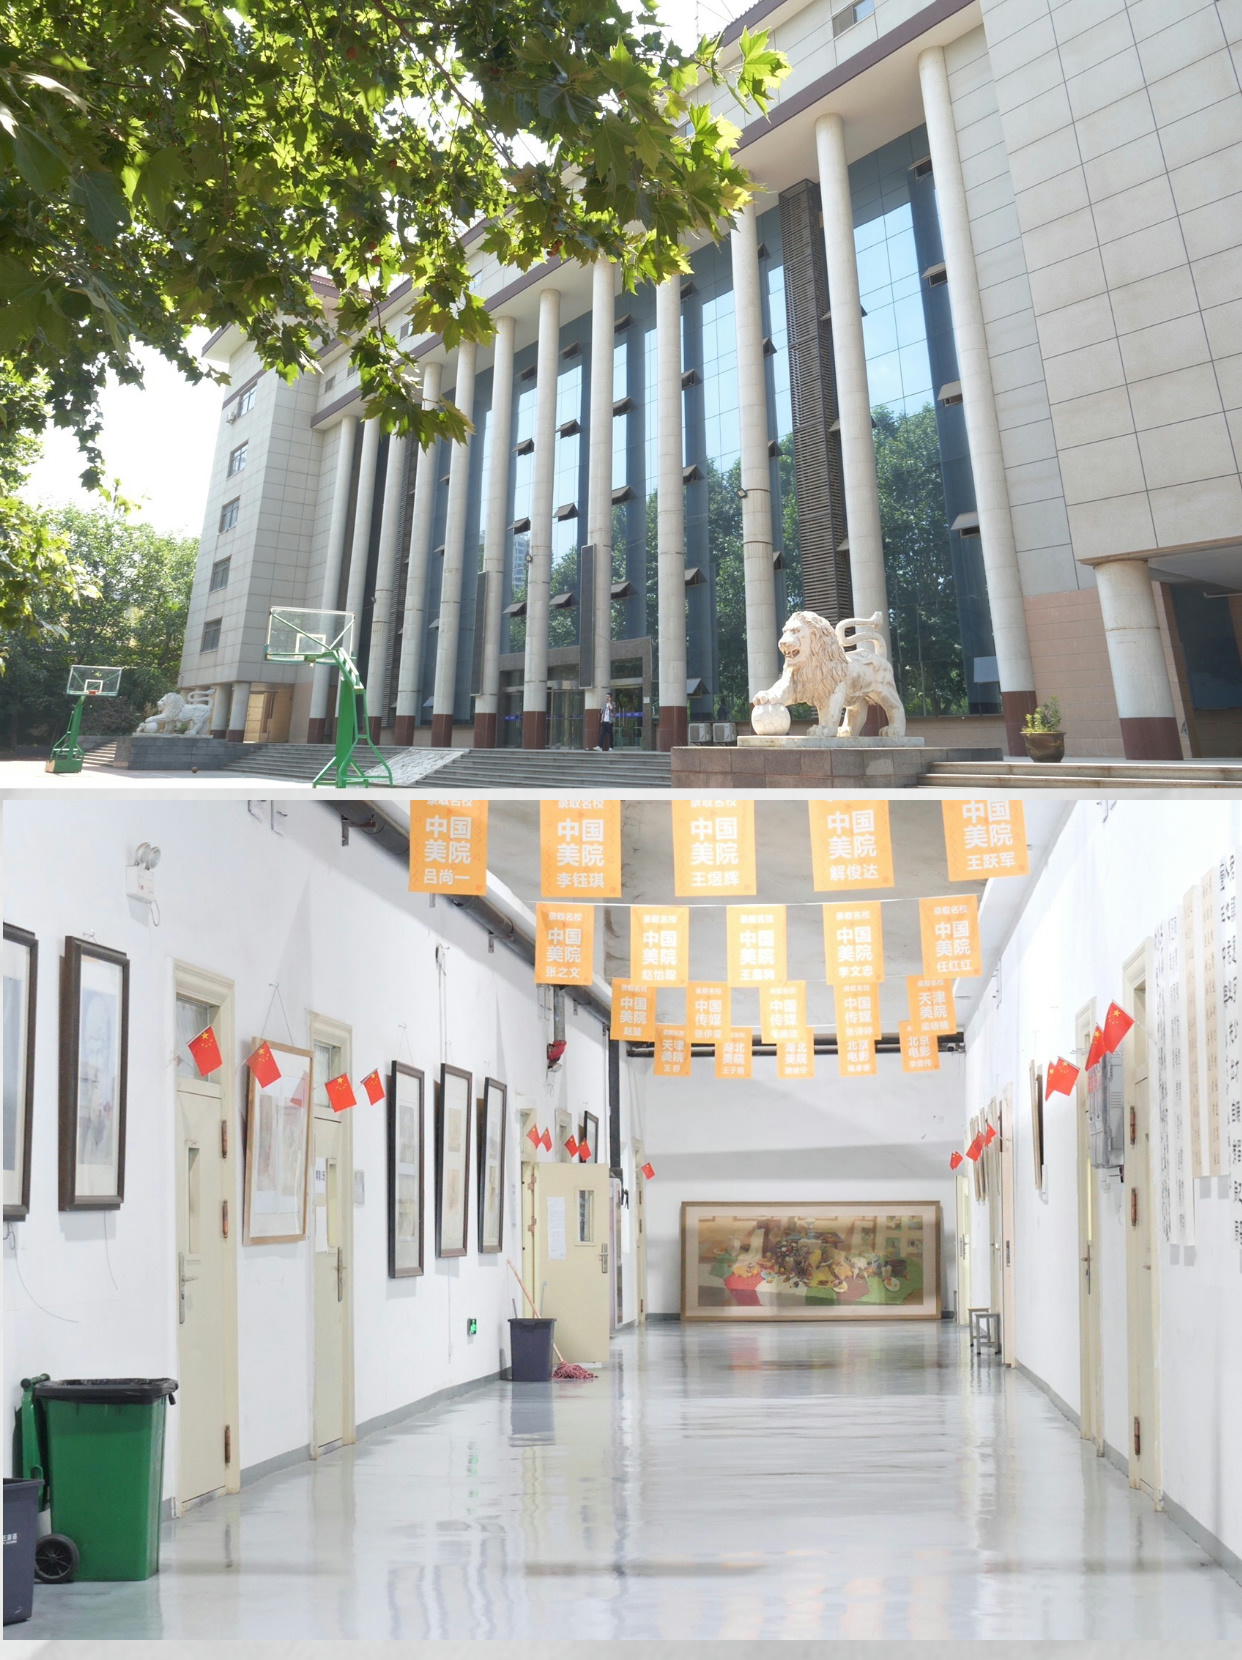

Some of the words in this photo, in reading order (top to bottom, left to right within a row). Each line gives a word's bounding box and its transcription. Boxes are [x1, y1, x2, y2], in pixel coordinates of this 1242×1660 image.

[962, 799, 1011, 824] 中国
[425, 816, 472, 840] 中国
[690, 817, 737, 841] 中国
[827, 809, 875, 834] 中国
[557, 819, 604, 842] 中国
[963, 822, 1014, 850] 美院
[424, 841, 472, 864] 美院
[556, 843, 604, 867] 美院
[690, 843, 738, 866] 美院
[828, 834, 877, 860] 美院
[966, 851, 1016, 871] 王跃军
[423, 869, 470, 885] 吕尚一
[556, 872, 605, 889] 李钰琪
[690, 870, 739, 888] 王煜辉
[830, 864, 879, 882] 解俊达
[548, 911, 583, 922] 录取名校
[547, 927, 581, 945] 中国
[835, 926, 871, 944] 中国
[934, 920, 969, 939] 中国
[642, 930, 677, 948] 中国
[739, 930, 775, 948] 中国
[545, 945, 581, 963] 美院
[836, 944, 872, 963] 美院
[935, 939, 971, 957] 美院
[641, 948, 677, 966] 美院
[739, 948, 775, 966] 美院
[544, 966, 581, 979] 张之文
[620, 997, 647, 1010] 中国
[694, 999, 722, 1013] 中国
[769, 999, 797, 1013] 中国
[843, 996, 871, 1011] 中国
[918, 990, 946, 1006] 天津
[620, 1010, 647, 1025] 美院
[694, 1013, 722, 1027] 传媒
[770, 1013, 798, 1027] 传媒
[844, 1010, 872, 1025] 传媒
[919, 1004, 948, 1020] 美院
[662, 1039, 684, 1051] 天津
[722, 1041, 745, 1053] 湖北
[846, 1039, 869, 1051] 北京
[907, 1035, 929, 1047] 北京
[661, 1051, 684, 1063] 美院
[722, 1053, 745, 1065] 美院
[785, 1053, 808, 1065] 美院
[847, 1051, 870, 1063] 电影
[908, 1045, 931, 1058] 电影
